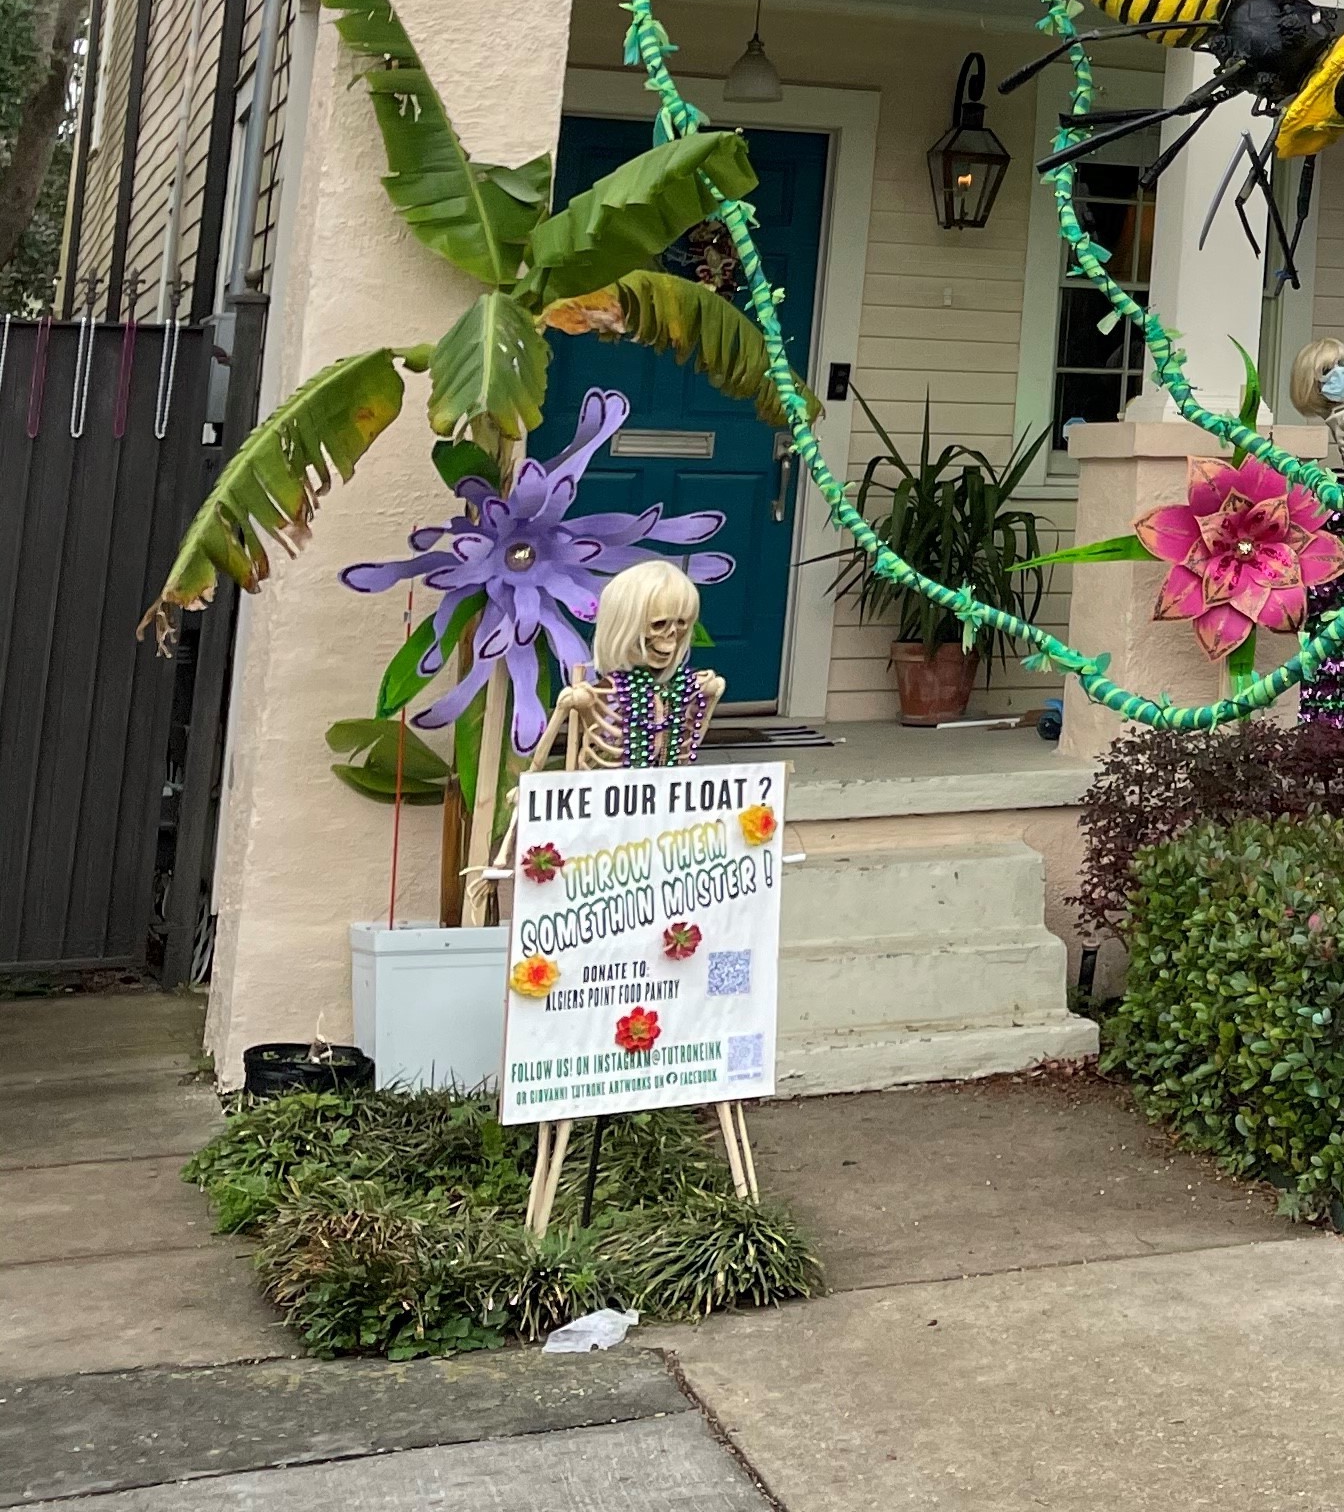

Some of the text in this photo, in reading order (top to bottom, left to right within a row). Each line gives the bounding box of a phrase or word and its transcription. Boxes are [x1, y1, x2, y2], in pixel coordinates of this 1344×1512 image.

[528, 776, 773, 823] LIKE OUR FLOAT ?
[560, 819, 727, 902] THROW THEM
[520, 849, 774, 958] SOMETHIN MISTER !
[583, 960, 651, 983] DONATE TO:
[545, 979, 681, 1012] ALGIERS POINT FOOD PANTRY
[511, 1060, 553, 1084] FOLLOW
[556, 1057, 573, 1079] US!
[576, 1055, 590, 1076] ON
